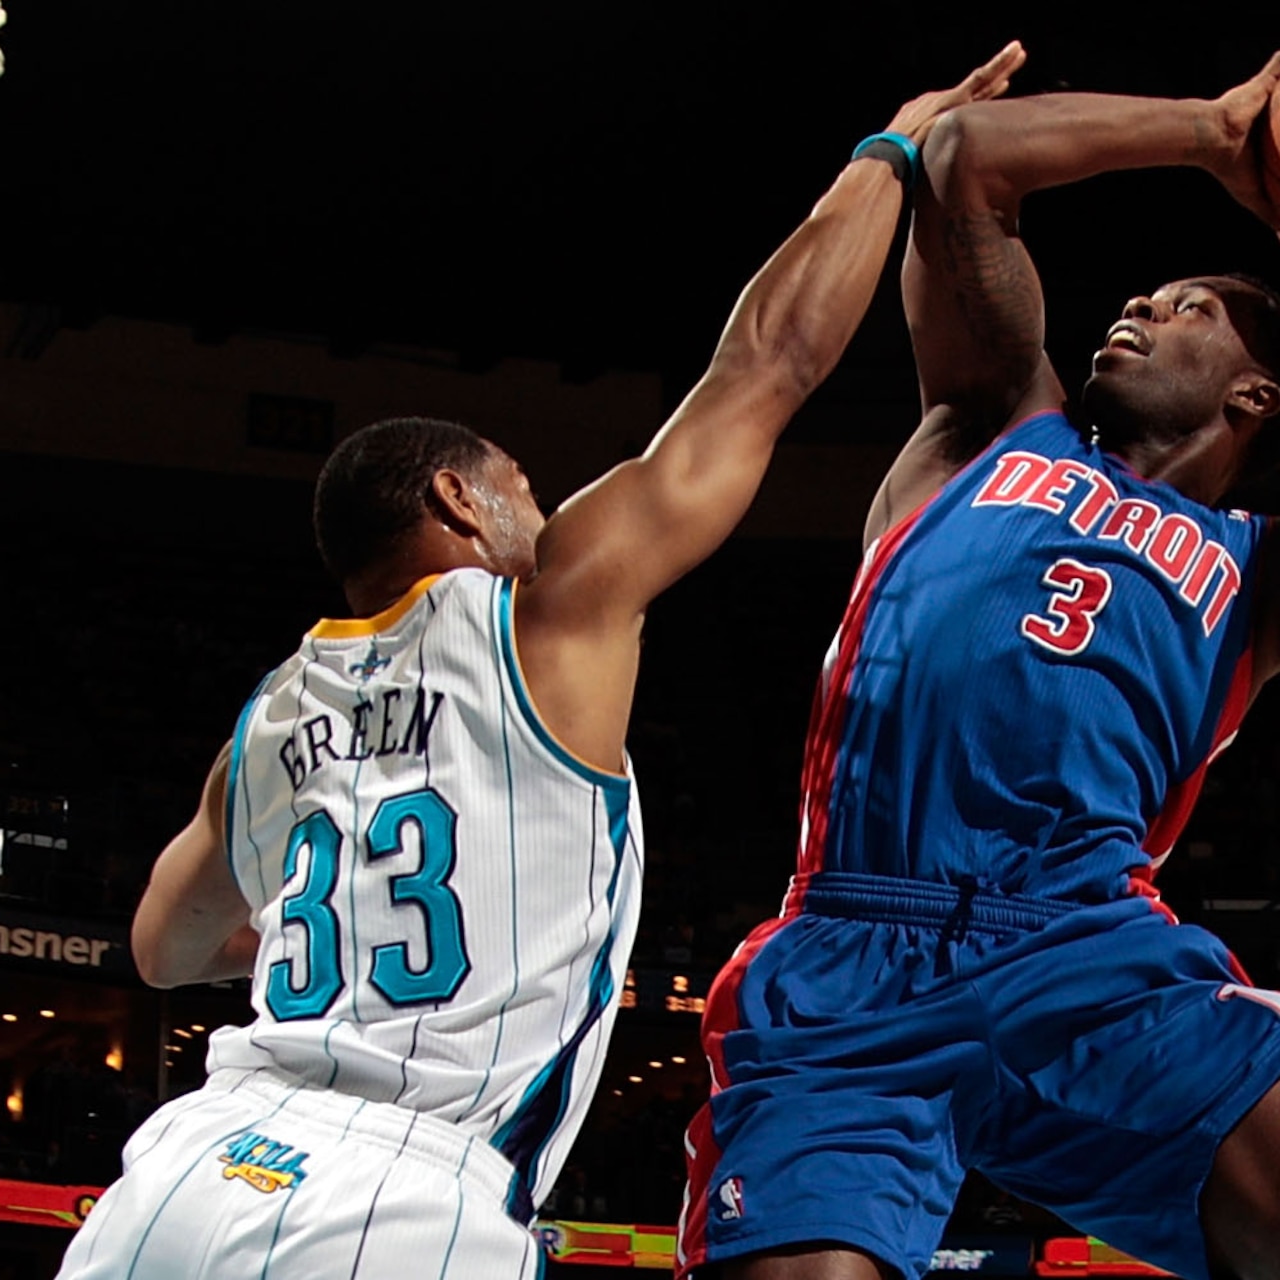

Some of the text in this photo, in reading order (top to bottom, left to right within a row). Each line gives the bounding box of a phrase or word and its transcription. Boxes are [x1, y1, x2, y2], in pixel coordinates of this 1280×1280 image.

[971, 450, 1242, 638] DETROIT
[1022, 557, 1113, 656] 3
[278, 687, 445, 792] GREEN
[266, 785, 472, 1024] 33
